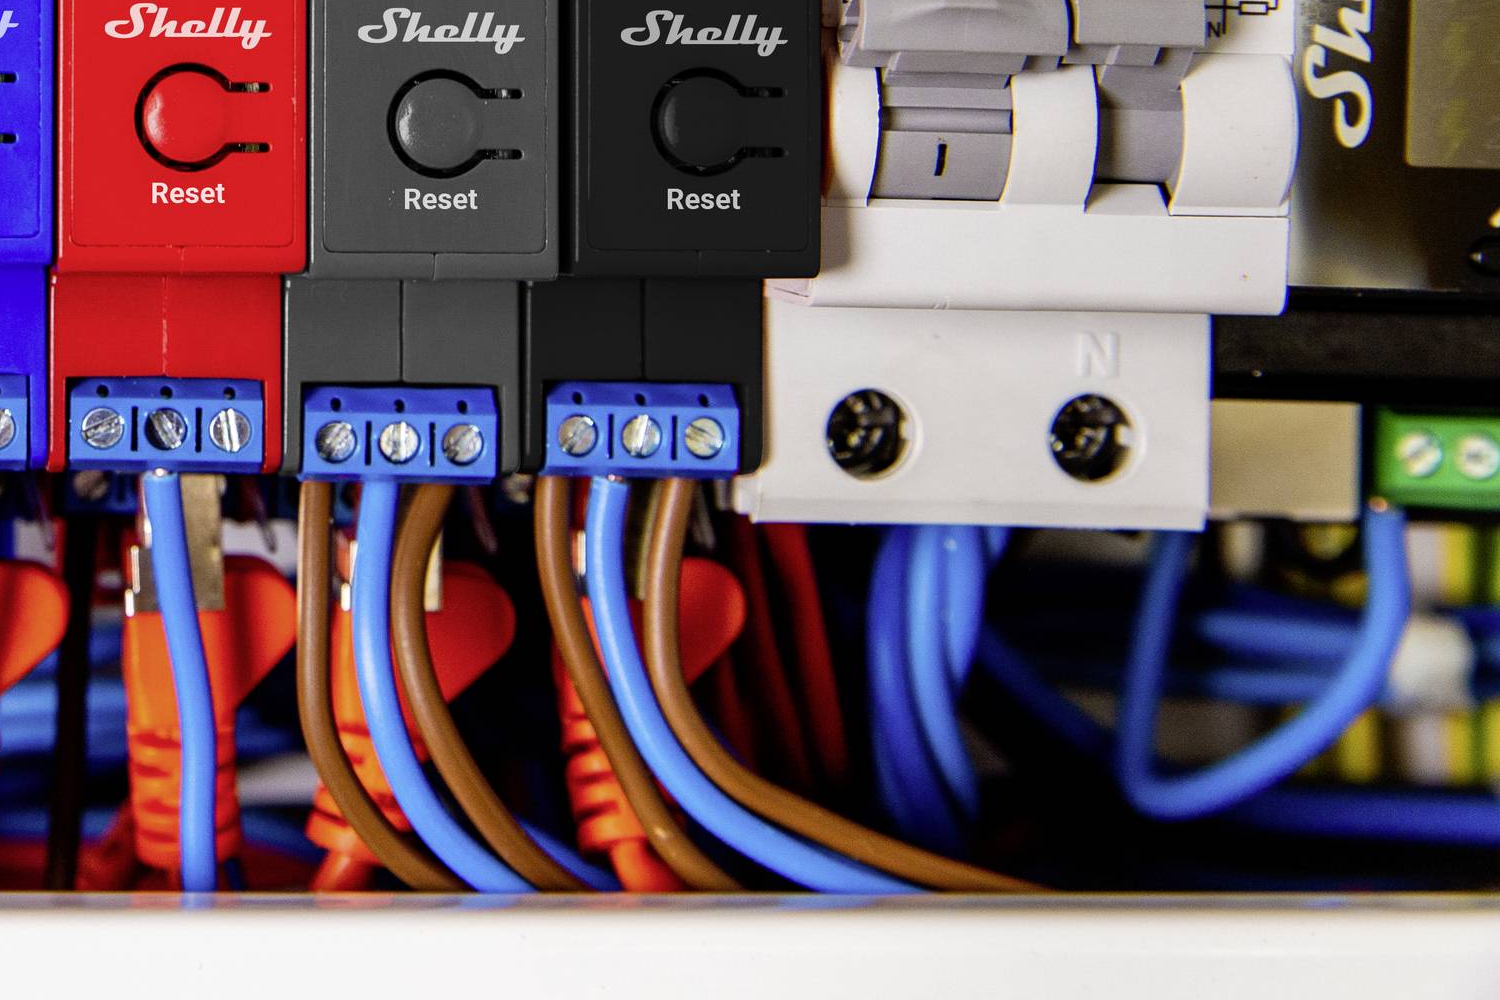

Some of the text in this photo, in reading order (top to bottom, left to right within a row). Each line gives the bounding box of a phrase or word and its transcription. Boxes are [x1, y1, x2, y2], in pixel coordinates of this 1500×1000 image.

[105, 3, 272, 49] Shelly
[358, 8, 525, 54] Shelly
[621, 10, 788, 56] Shelly
[1207, 22, 1220, 38] N
[152, 183, 225, 203] Reset
[405, 189, 477, 209] Reset
[668, 189, 740, 209] Reset
[1077, 332, 1120, 377] N
